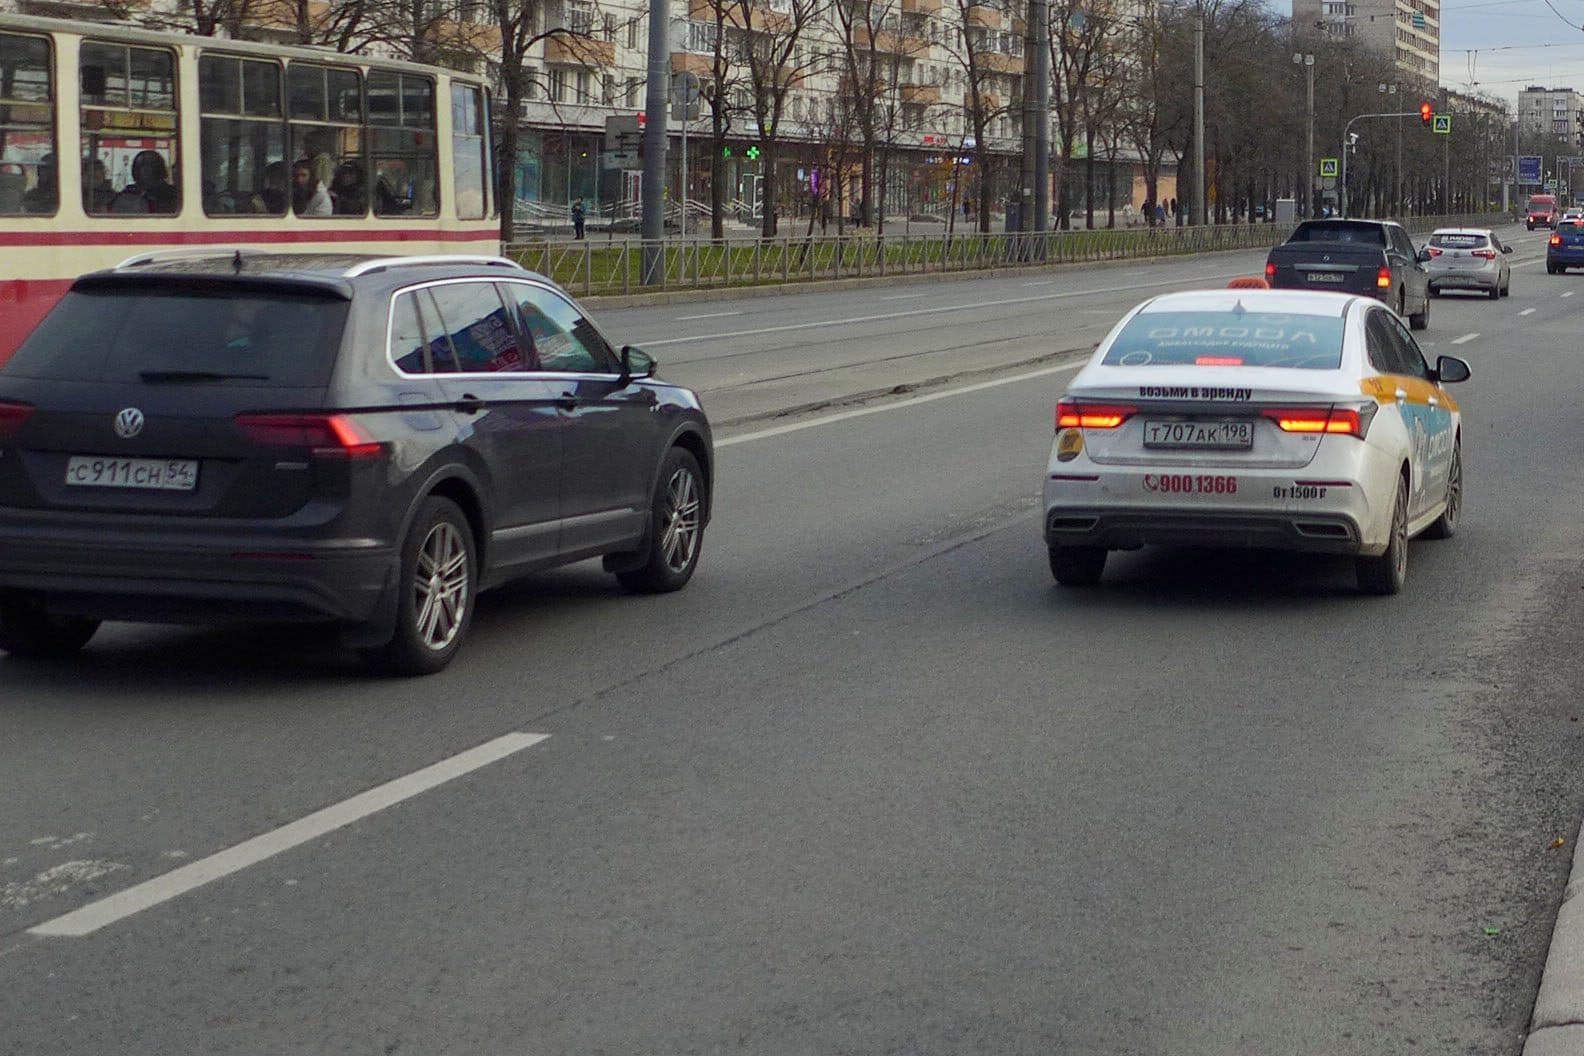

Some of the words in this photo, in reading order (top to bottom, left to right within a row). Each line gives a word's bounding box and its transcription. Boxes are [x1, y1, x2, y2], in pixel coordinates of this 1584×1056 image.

[1149, 326, 1317, 344] OMODA
[1139, 386, 1189, 398] возьми
[1193, 387, 1199, 398] в
[1201, 387, 1252, 400] аренду
[1150, 424, 1218, 442] Т707АК
[1221, 422, 1248, 439] 198
[75, 461, 161, 484] С911СН
[167, 460, 190, 479] 54
[1272, 485, 1288, 498] От
[1290, 485, 1318, 499] 1500
